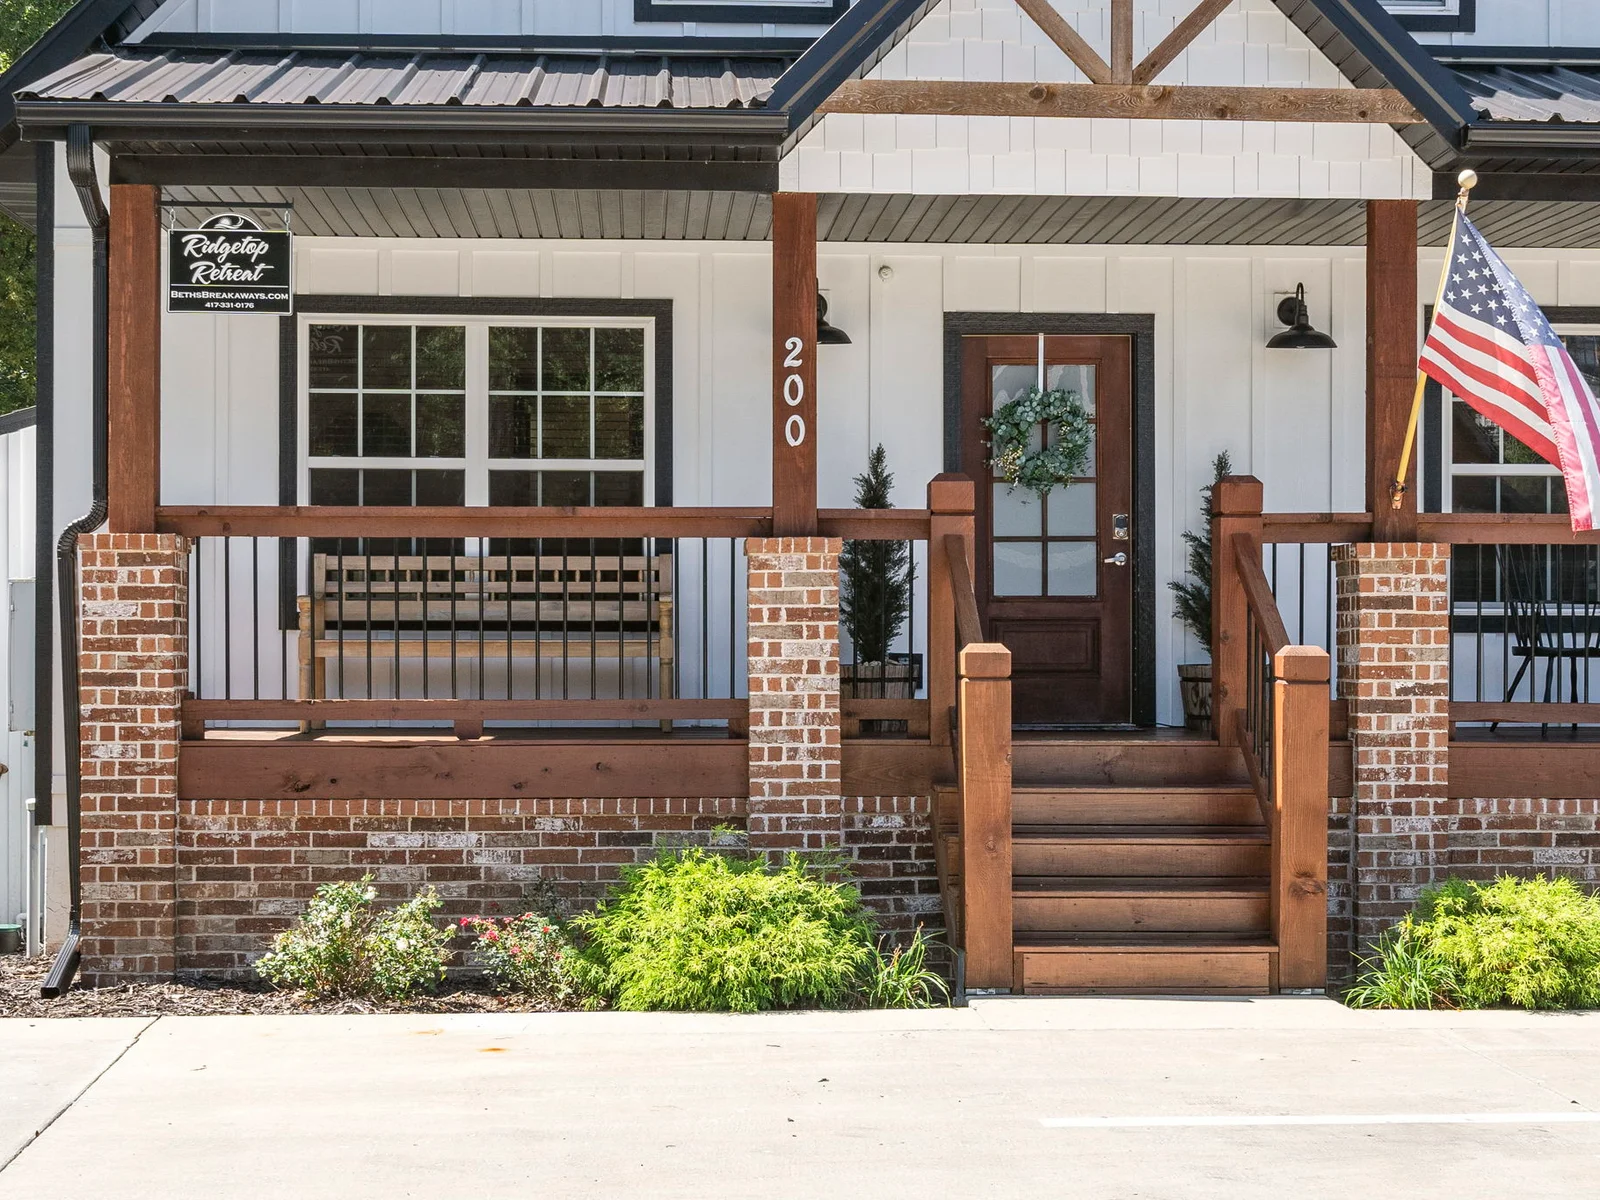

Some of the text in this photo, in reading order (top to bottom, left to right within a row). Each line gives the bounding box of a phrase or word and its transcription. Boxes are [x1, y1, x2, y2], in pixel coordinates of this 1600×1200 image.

[181, 234, 269, 263] Ridgetop
[189, 261, 275, 285] Retreat
[204, 301, 255, 309] 417-331-0176
[783, 336, 806, 447] 200
